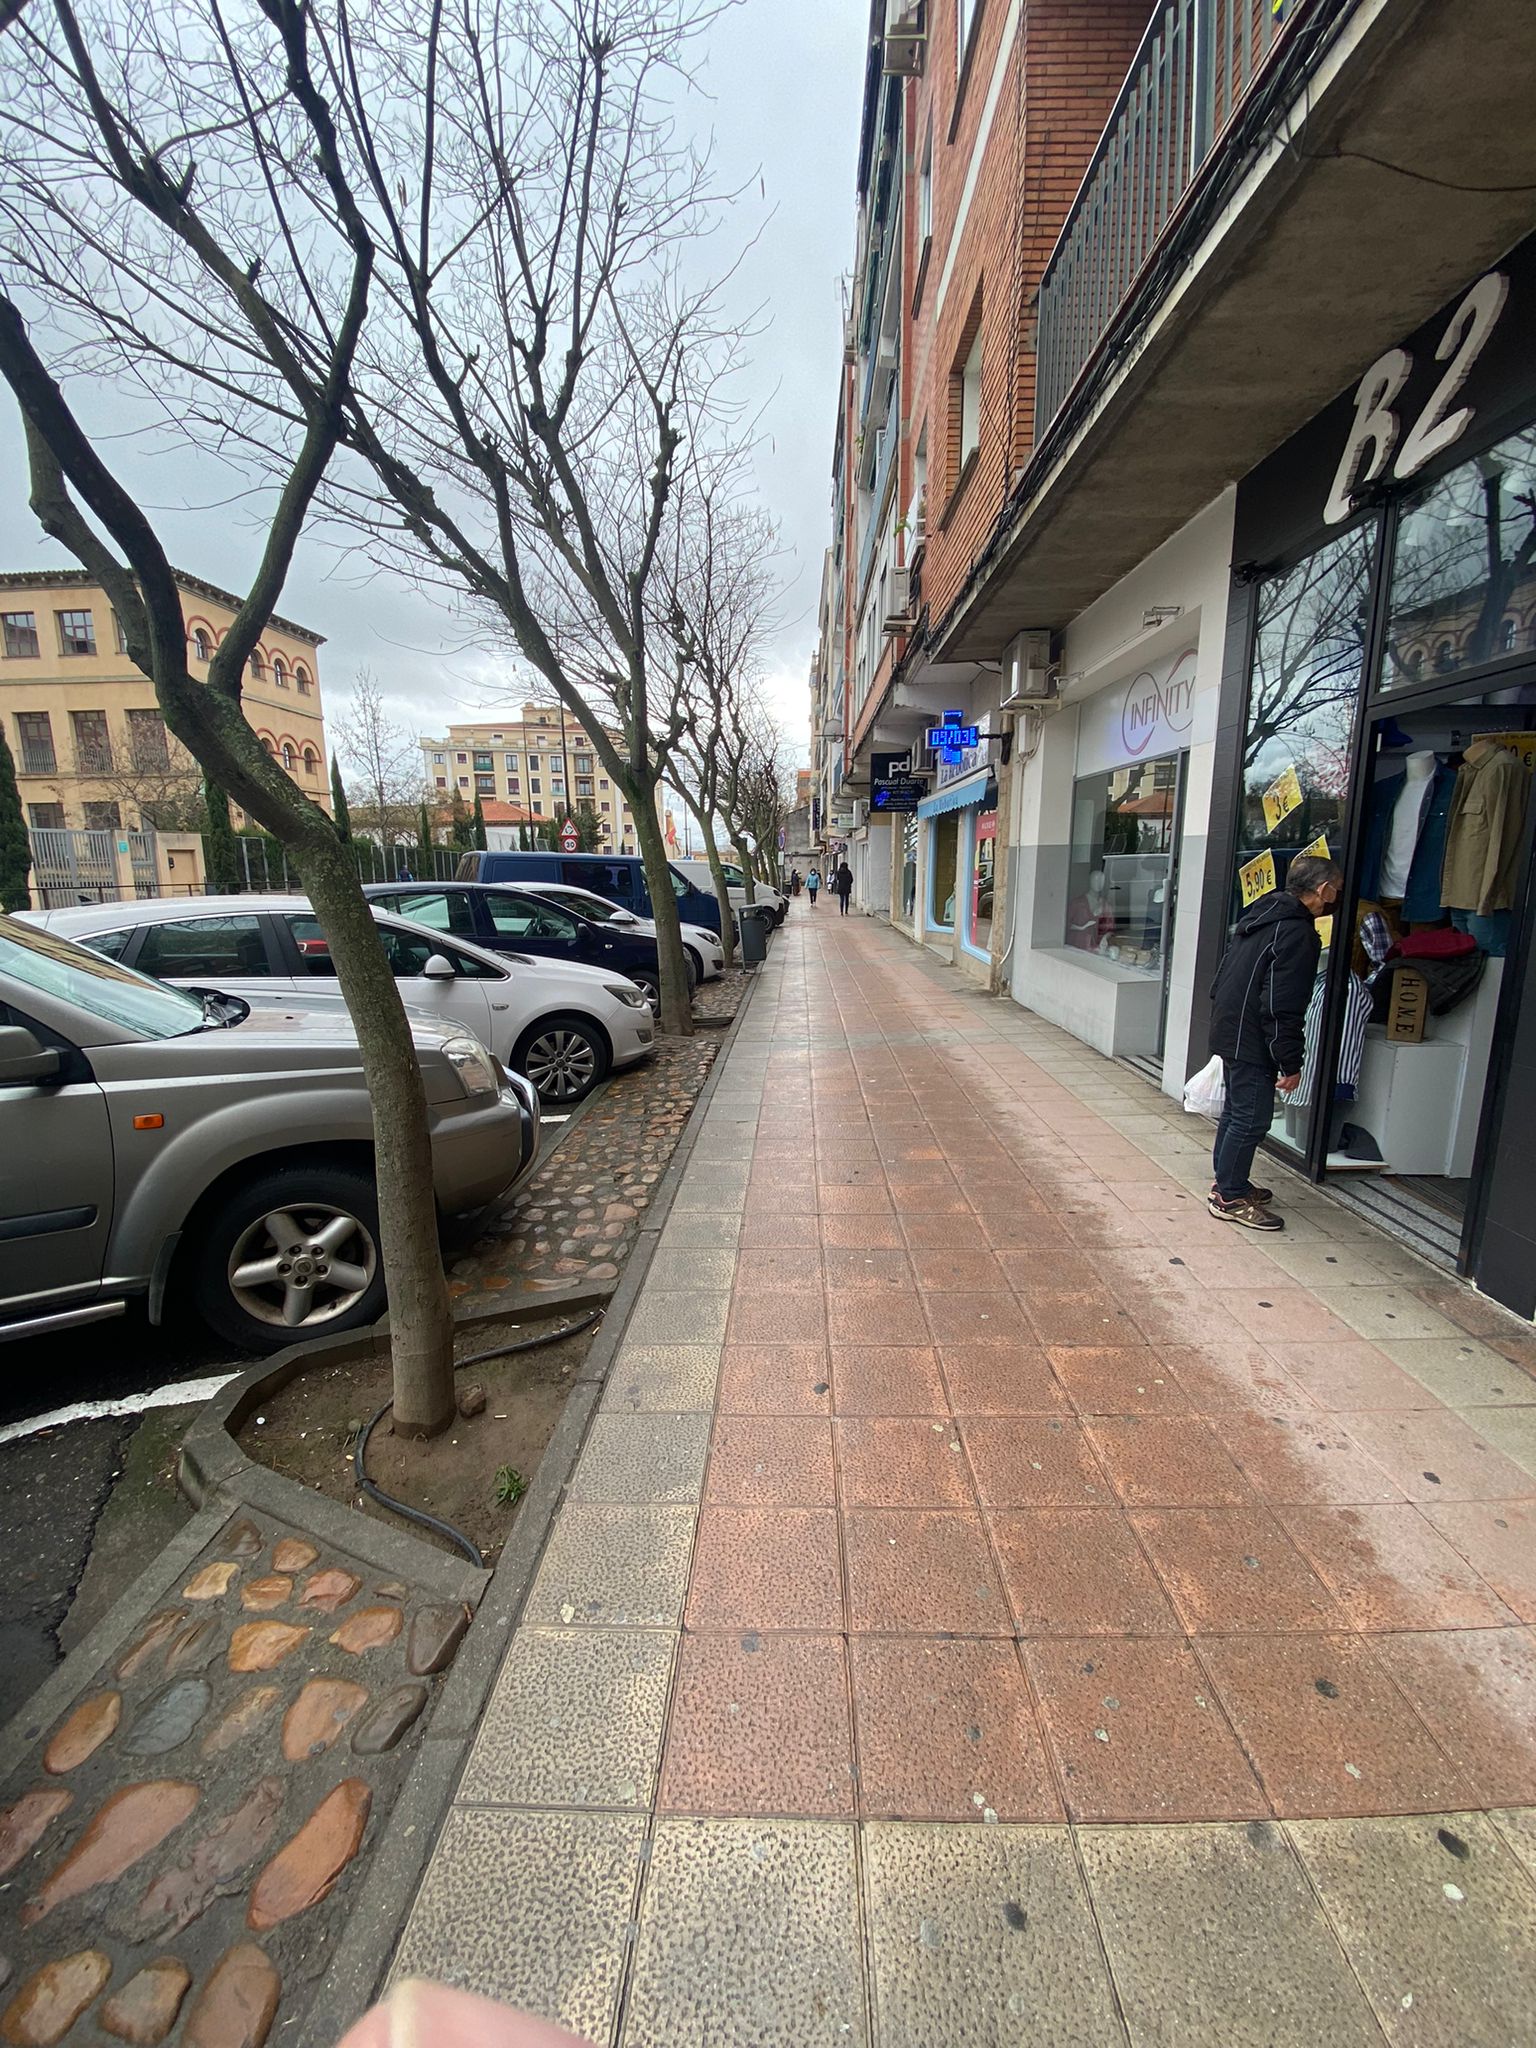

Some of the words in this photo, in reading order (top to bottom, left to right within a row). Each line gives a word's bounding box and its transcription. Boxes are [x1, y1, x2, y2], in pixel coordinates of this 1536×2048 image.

[1130, 675, 1197, 731] INFINITY
[889, 755, 910, 778] pd
[1246, 868, 1265, 899] 5,90
[1266, 870, 1272, 885] €
[1395, 977, 1421, 1033] HOME
